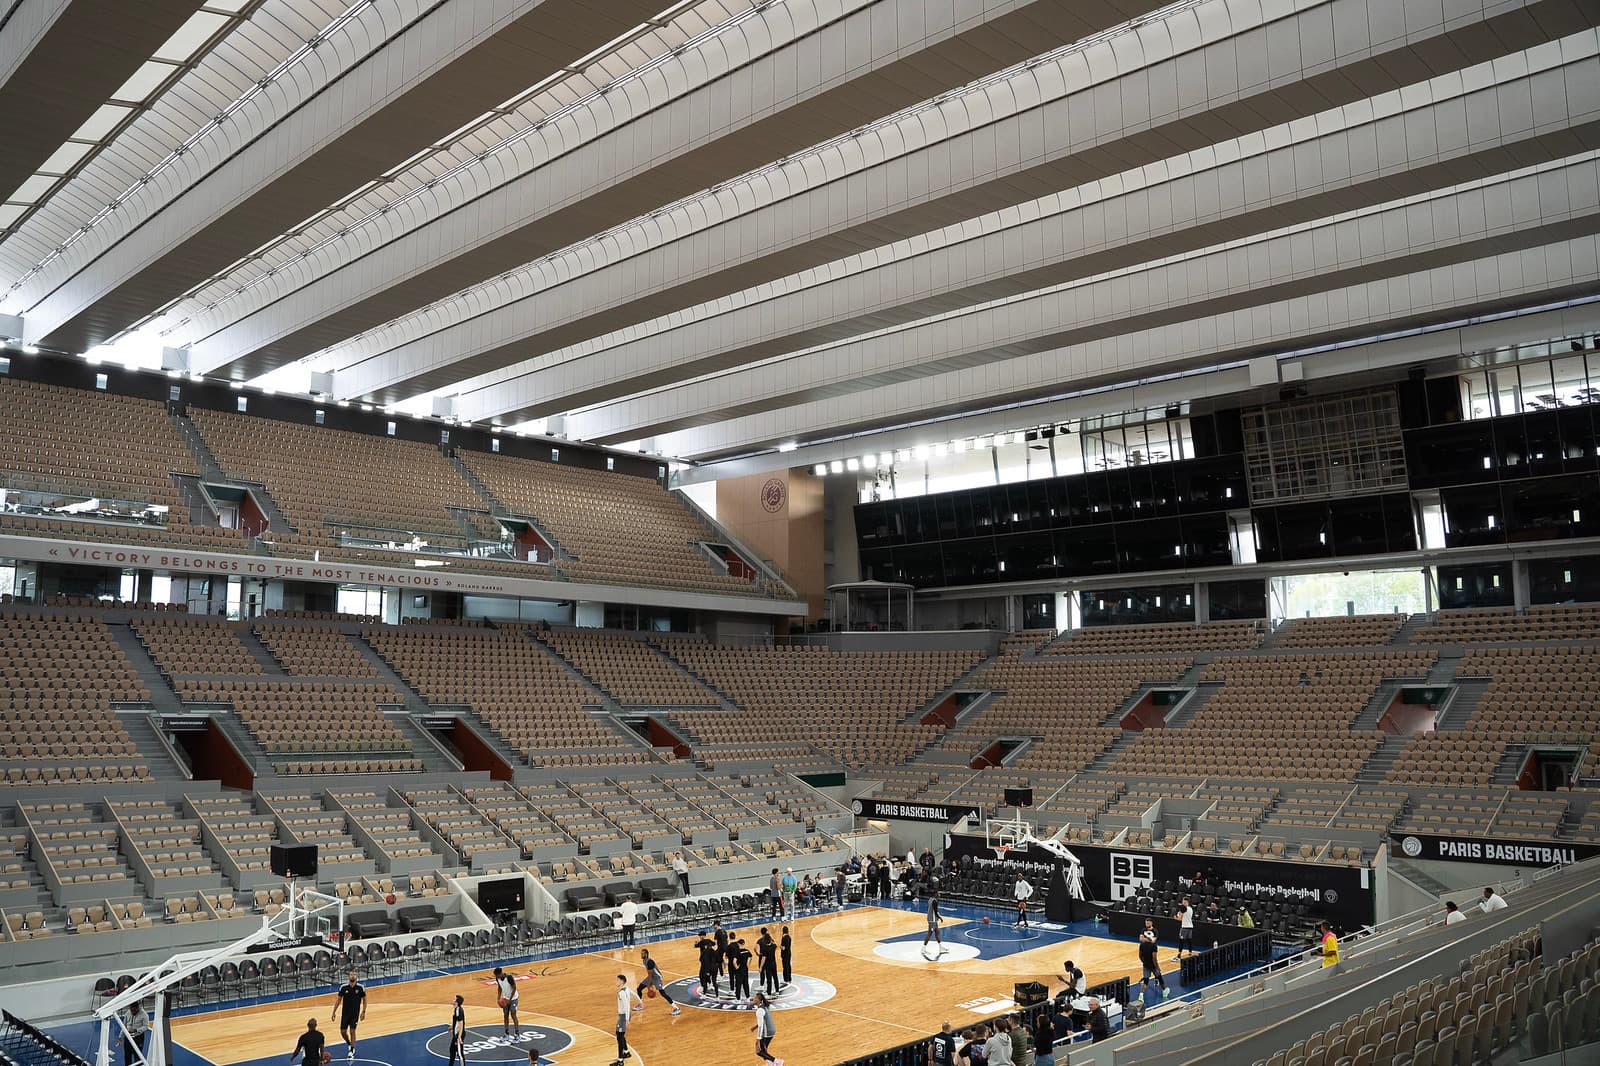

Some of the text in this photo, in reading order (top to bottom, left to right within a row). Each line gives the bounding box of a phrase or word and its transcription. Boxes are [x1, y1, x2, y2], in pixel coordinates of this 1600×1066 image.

[68, 547, 151, 565] VICTORY
[161, 556, 239, 571] BELONGS
[247, 562, 267, 573] TO
[275, 565, 303, 576] THE
[312, 568, 351, 580] MOST
[360, 571, 440, 586] TENACIOUS
[875, 803, 949, 820] PARIS BASKETBALL
[1439, 841, 1576, 865] PARIS BASKETBALL
[1034, 861, 1051, 874] Paris
[1255, 882, 1276, 896] Paris
[1276, 885, 1320, 902] Basketball
